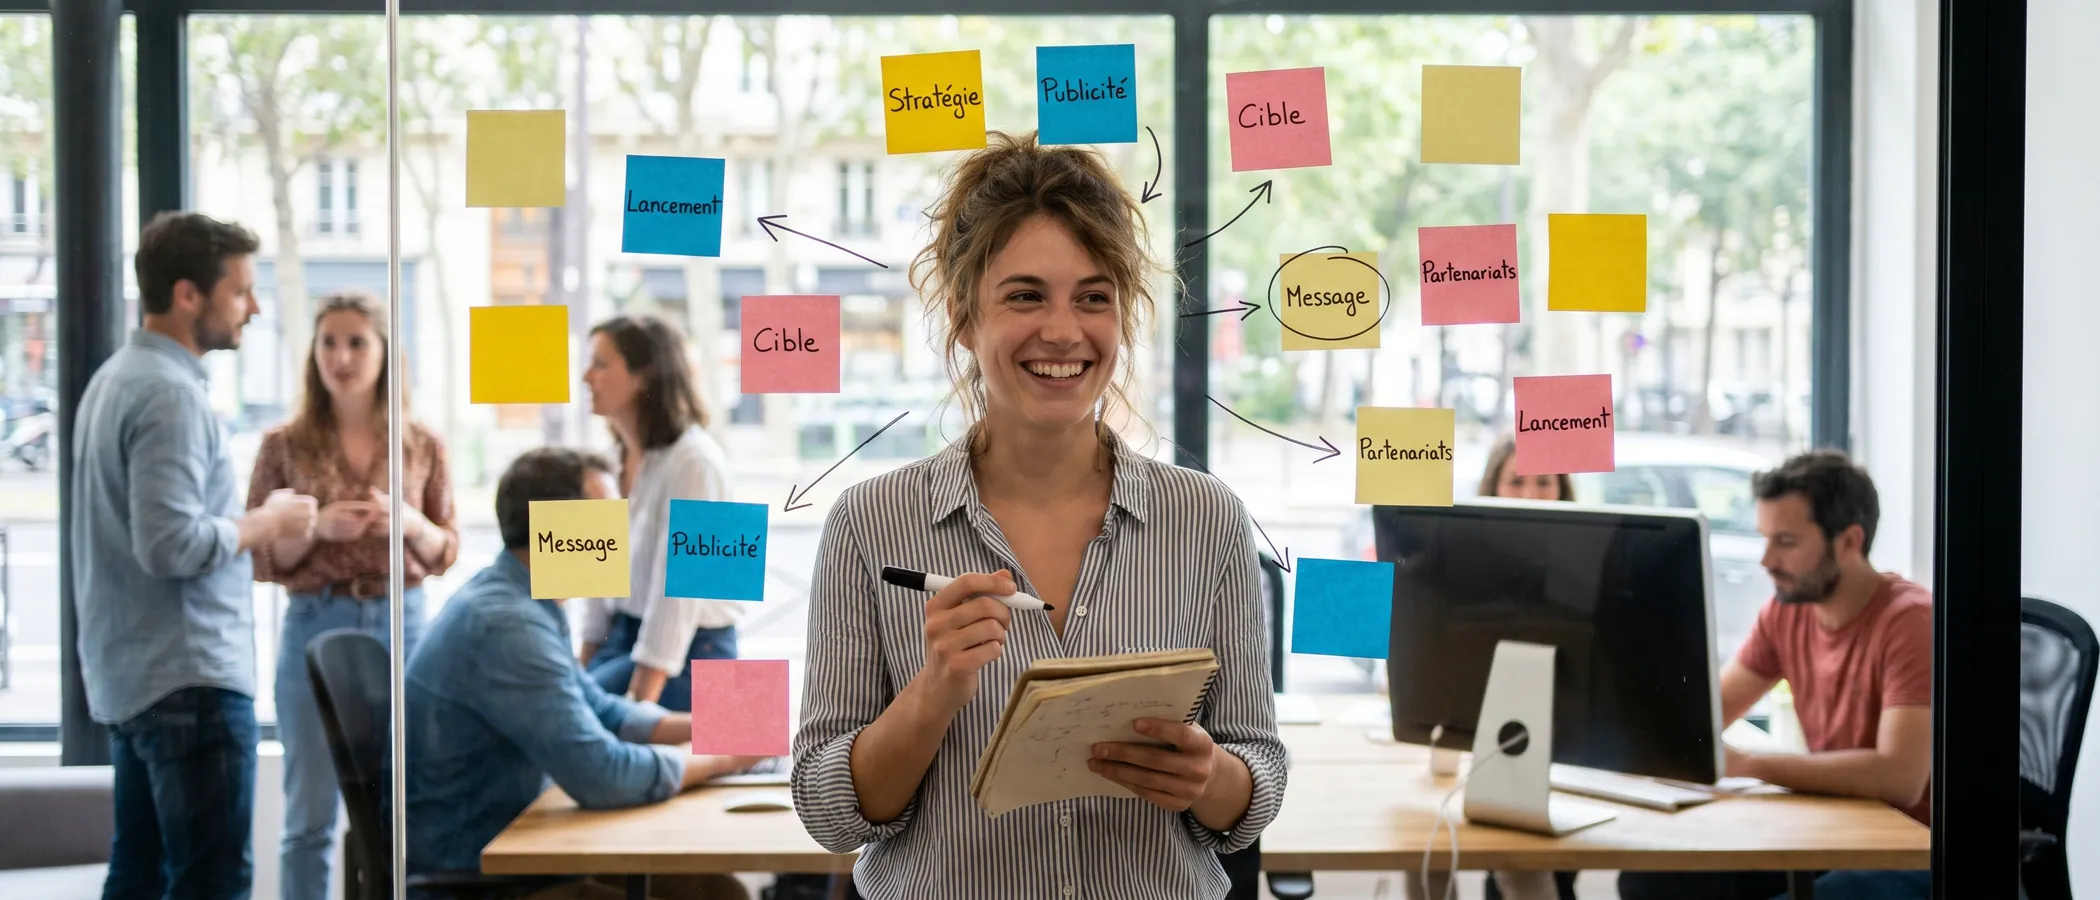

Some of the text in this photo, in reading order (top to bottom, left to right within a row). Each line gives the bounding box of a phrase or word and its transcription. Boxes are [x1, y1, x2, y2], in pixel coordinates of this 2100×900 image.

[889, 83, 982, 120] Stratégie
[1041, 76, 1128, 103] Publicité
[1238, 101, 1306, 129] Cible
[627, 189, 722, 215] Lancement
[1422, 259, 1517, 284] Partenariats
[1286, 284, 1370, 317] Message
[753, 327, 820, 353] Cible
[1519, 406, 1611, 433] Lancement
[1359, 437, 1453, 461] Partenariats
[538, 530, 618, 562] Message
[671, 531, 761, 558] Publicité
